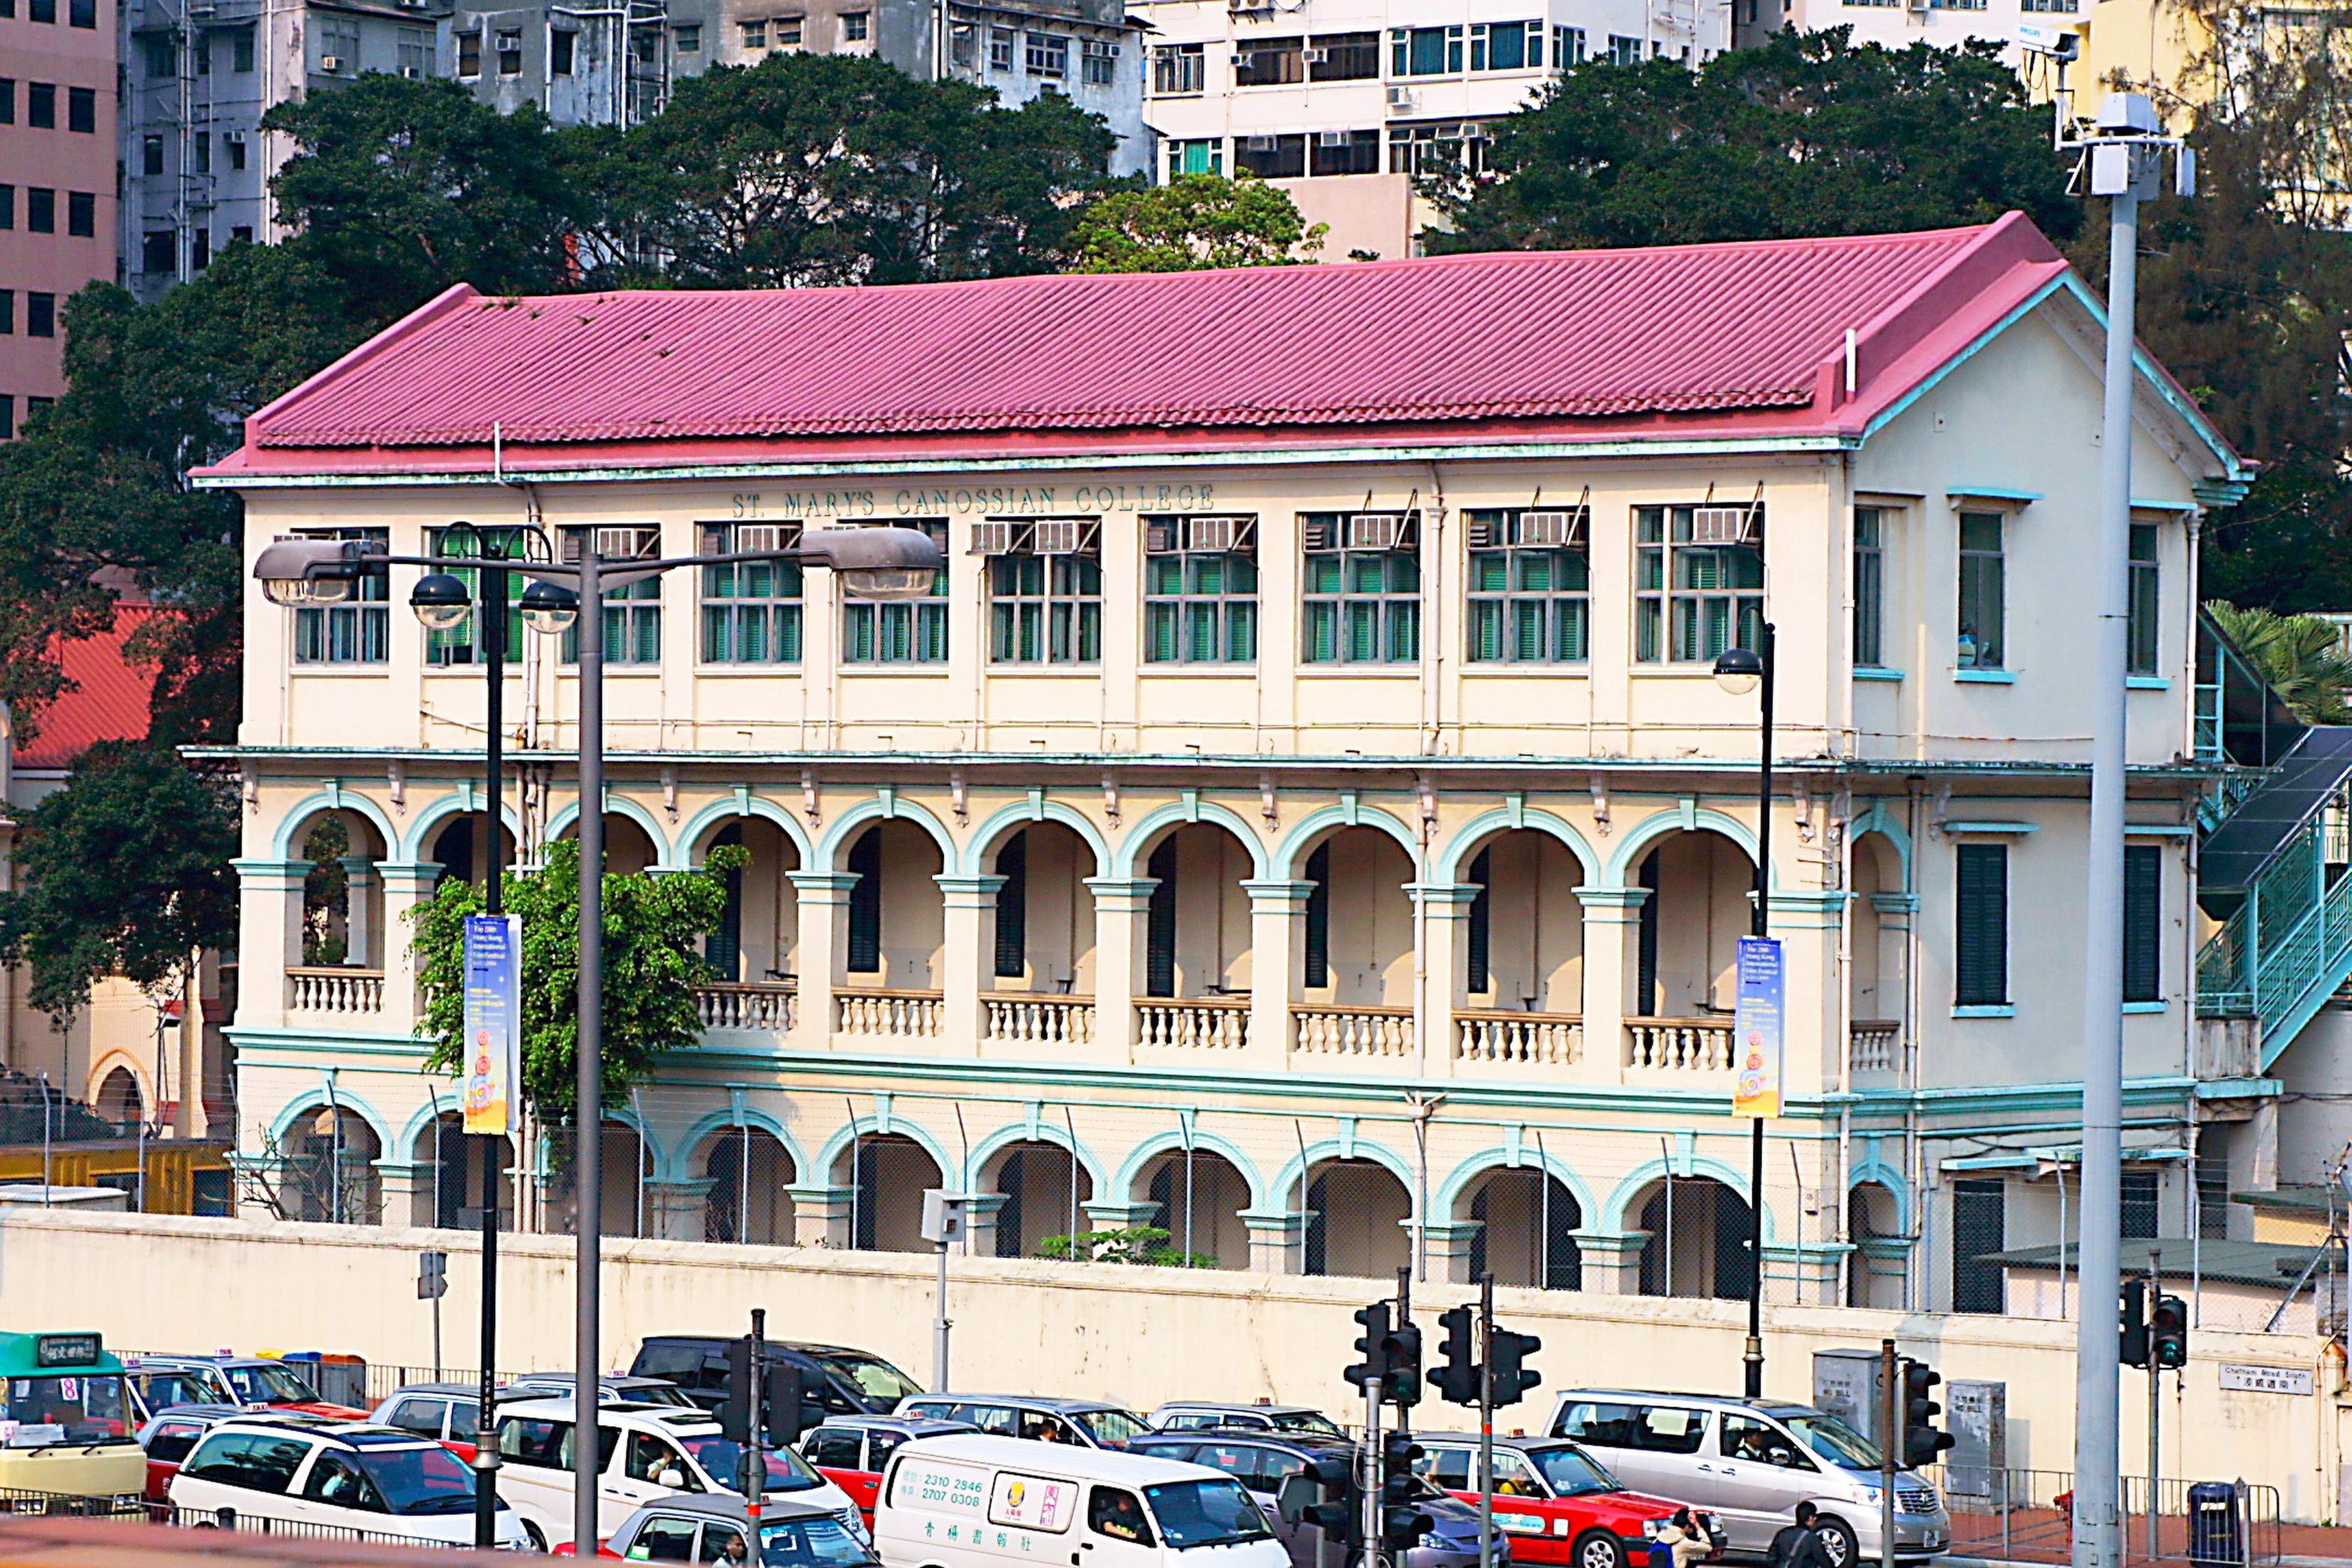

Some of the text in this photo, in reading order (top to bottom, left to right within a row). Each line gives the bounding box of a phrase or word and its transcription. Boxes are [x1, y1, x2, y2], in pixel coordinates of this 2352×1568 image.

[732, 484, 1214, 517] ST. MARY'S CANOSSIAN COLLEGE
[2225, 1366, 2306, 1379] Chatham Road South
[64, 1377, 75, 1399] 8
[924, 1474, 950, 1487] 2310
[954, 1478, 982, 1493] 2846
[922, 1488, 947, 1501] 2707
